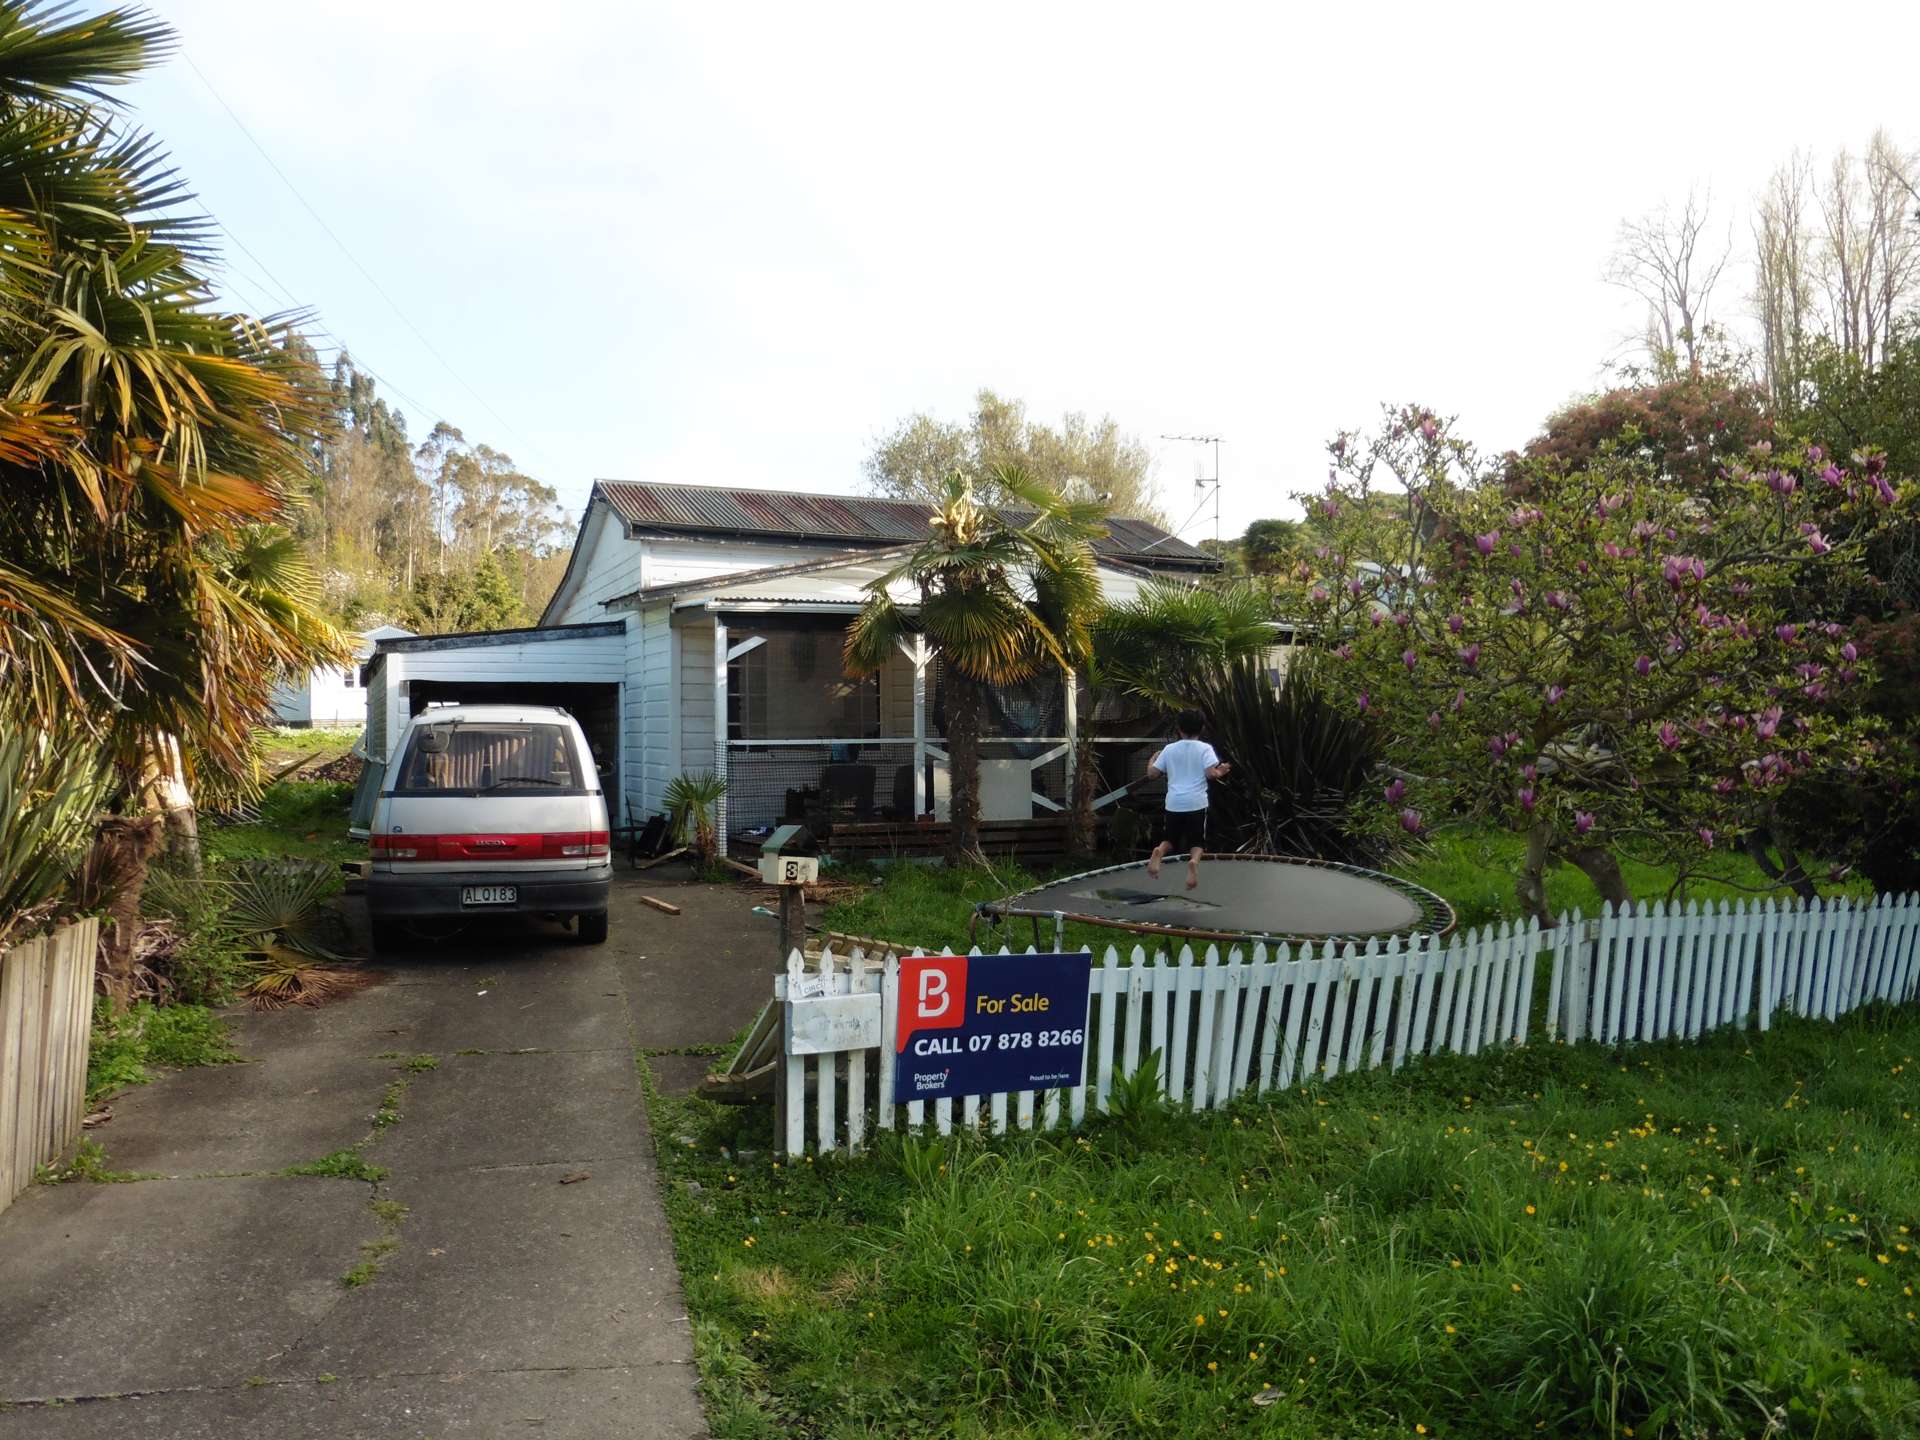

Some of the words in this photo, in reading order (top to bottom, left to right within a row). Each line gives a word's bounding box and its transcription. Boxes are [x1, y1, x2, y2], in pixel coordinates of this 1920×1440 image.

[786, 863, 798, 878] 3
[976, 996, 1006, 1014] For
[1011, 993, 1049, 1012] Sale
[914, 1037, 963, 1056] CALL
[969, 1035, 992, 1052] 07
[998, 1032, 1033, 1050] 878
[1038, 1029, 1083, 1047] 8266
[914, 1071, 948, 1082] Property
[916, 1080, 945, 1090] Brokers
